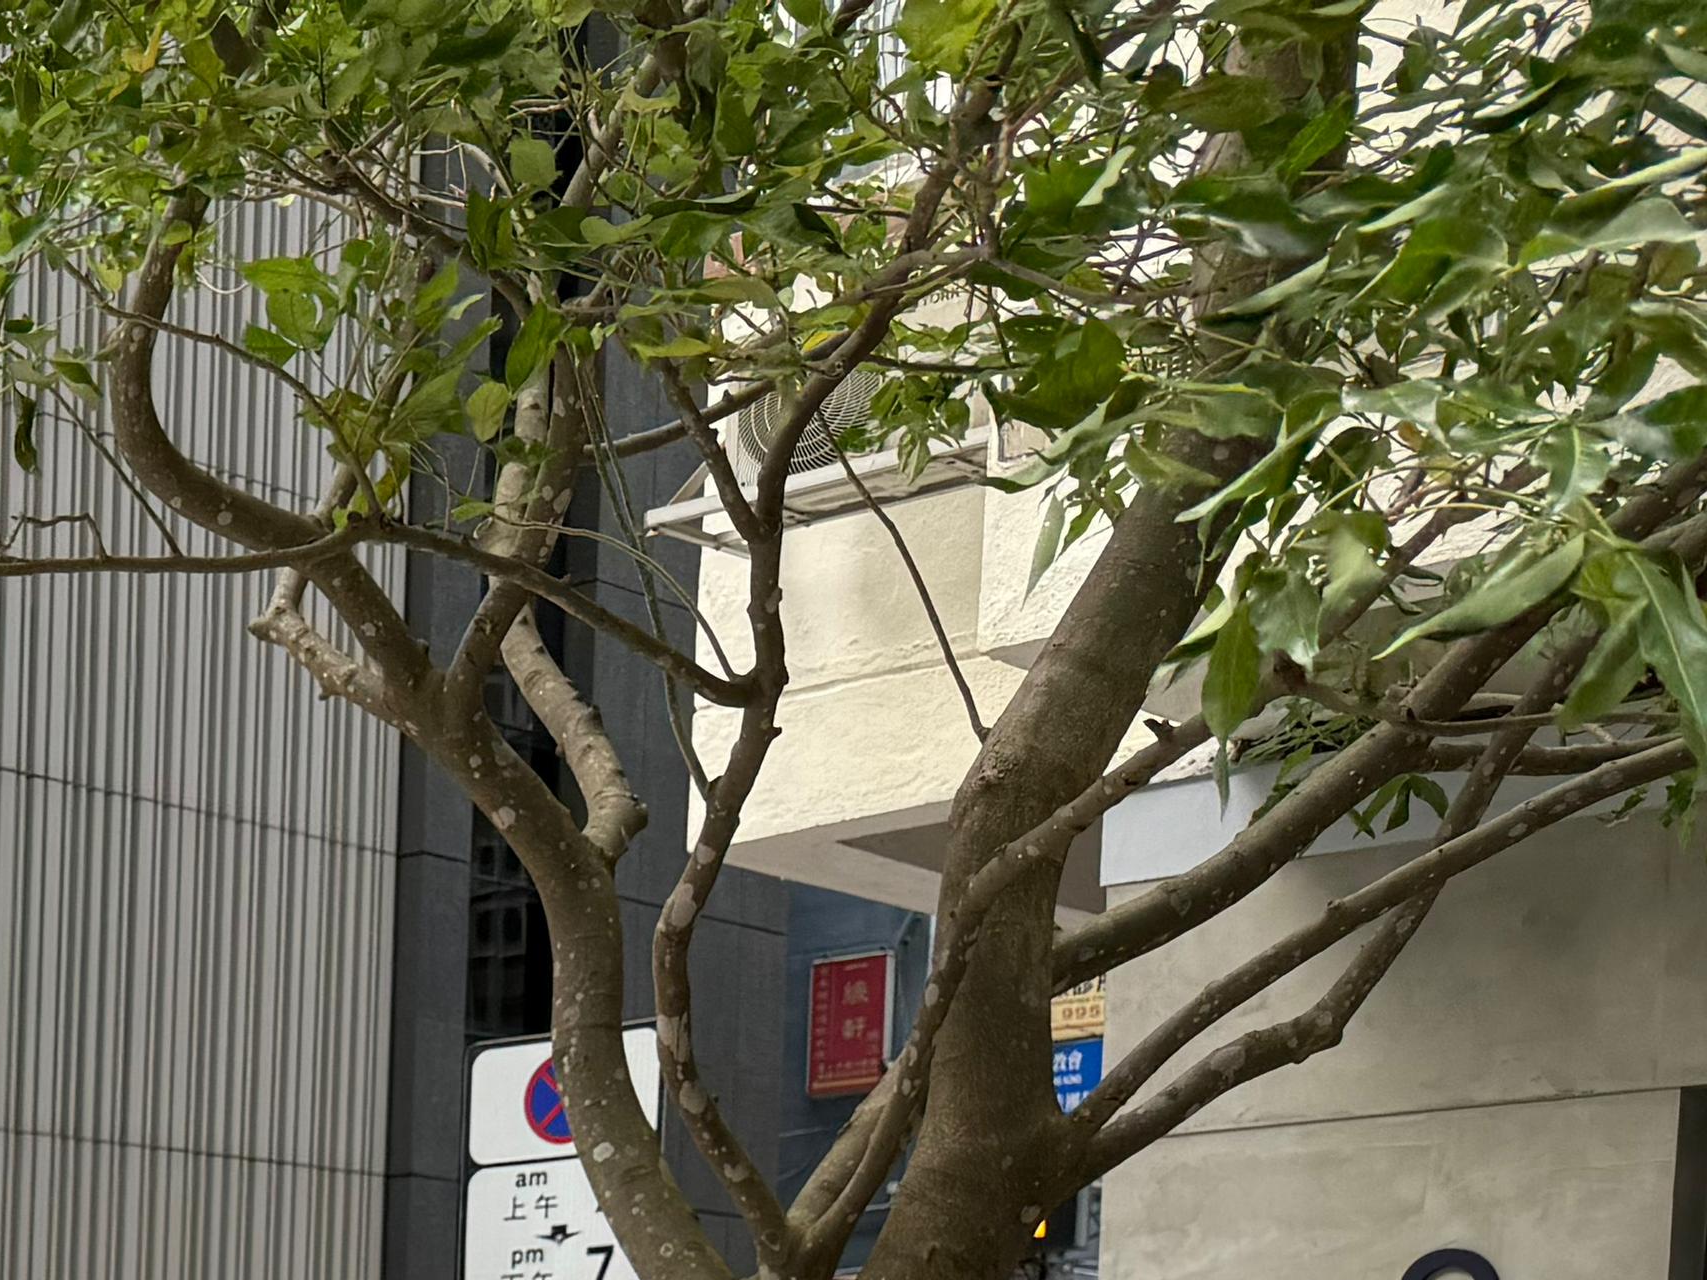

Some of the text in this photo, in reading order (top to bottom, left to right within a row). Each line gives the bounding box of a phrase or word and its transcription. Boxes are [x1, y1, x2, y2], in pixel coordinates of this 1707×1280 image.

[515, 1172, 548, 1188] am
[503, 1194, 558, 1221] 上午
[511, 1248, 544, 1269] pm
